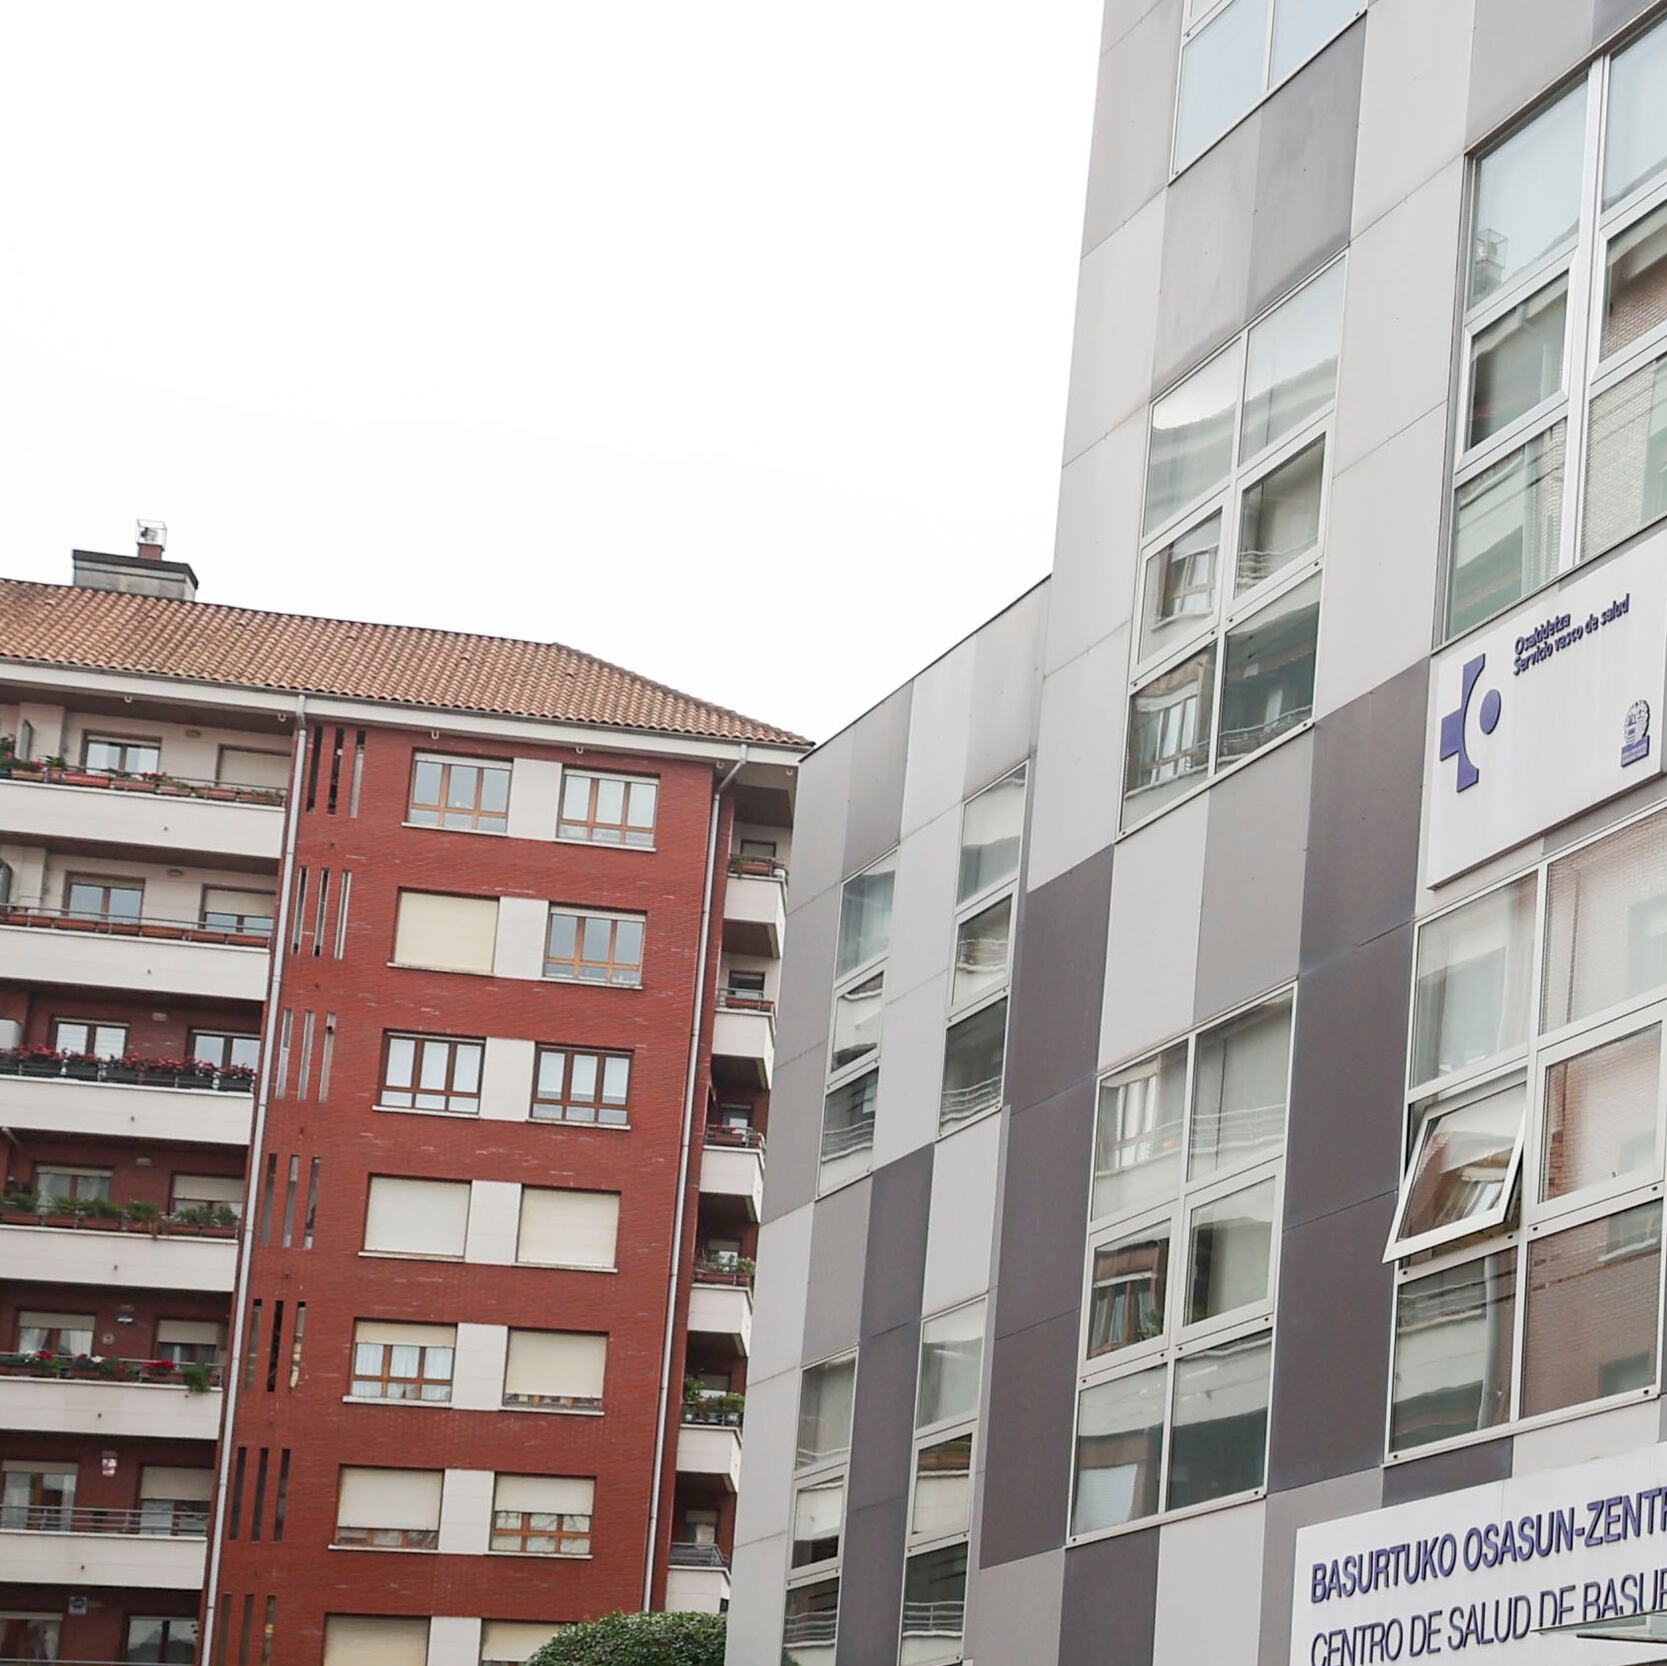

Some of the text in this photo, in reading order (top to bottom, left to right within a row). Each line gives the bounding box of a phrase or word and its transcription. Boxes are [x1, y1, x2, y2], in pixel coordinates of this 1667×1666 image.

[1513, 593, 1630, 676] Servicio vasco de salud
[1515, 613, 1571, 656] Osakidetza
[1311, 1532, 1457, 1604] BASURTUKO
[1409, 1609, 1443, 1659] DE
[1448, 1594, 1531, 1650] SALUD
